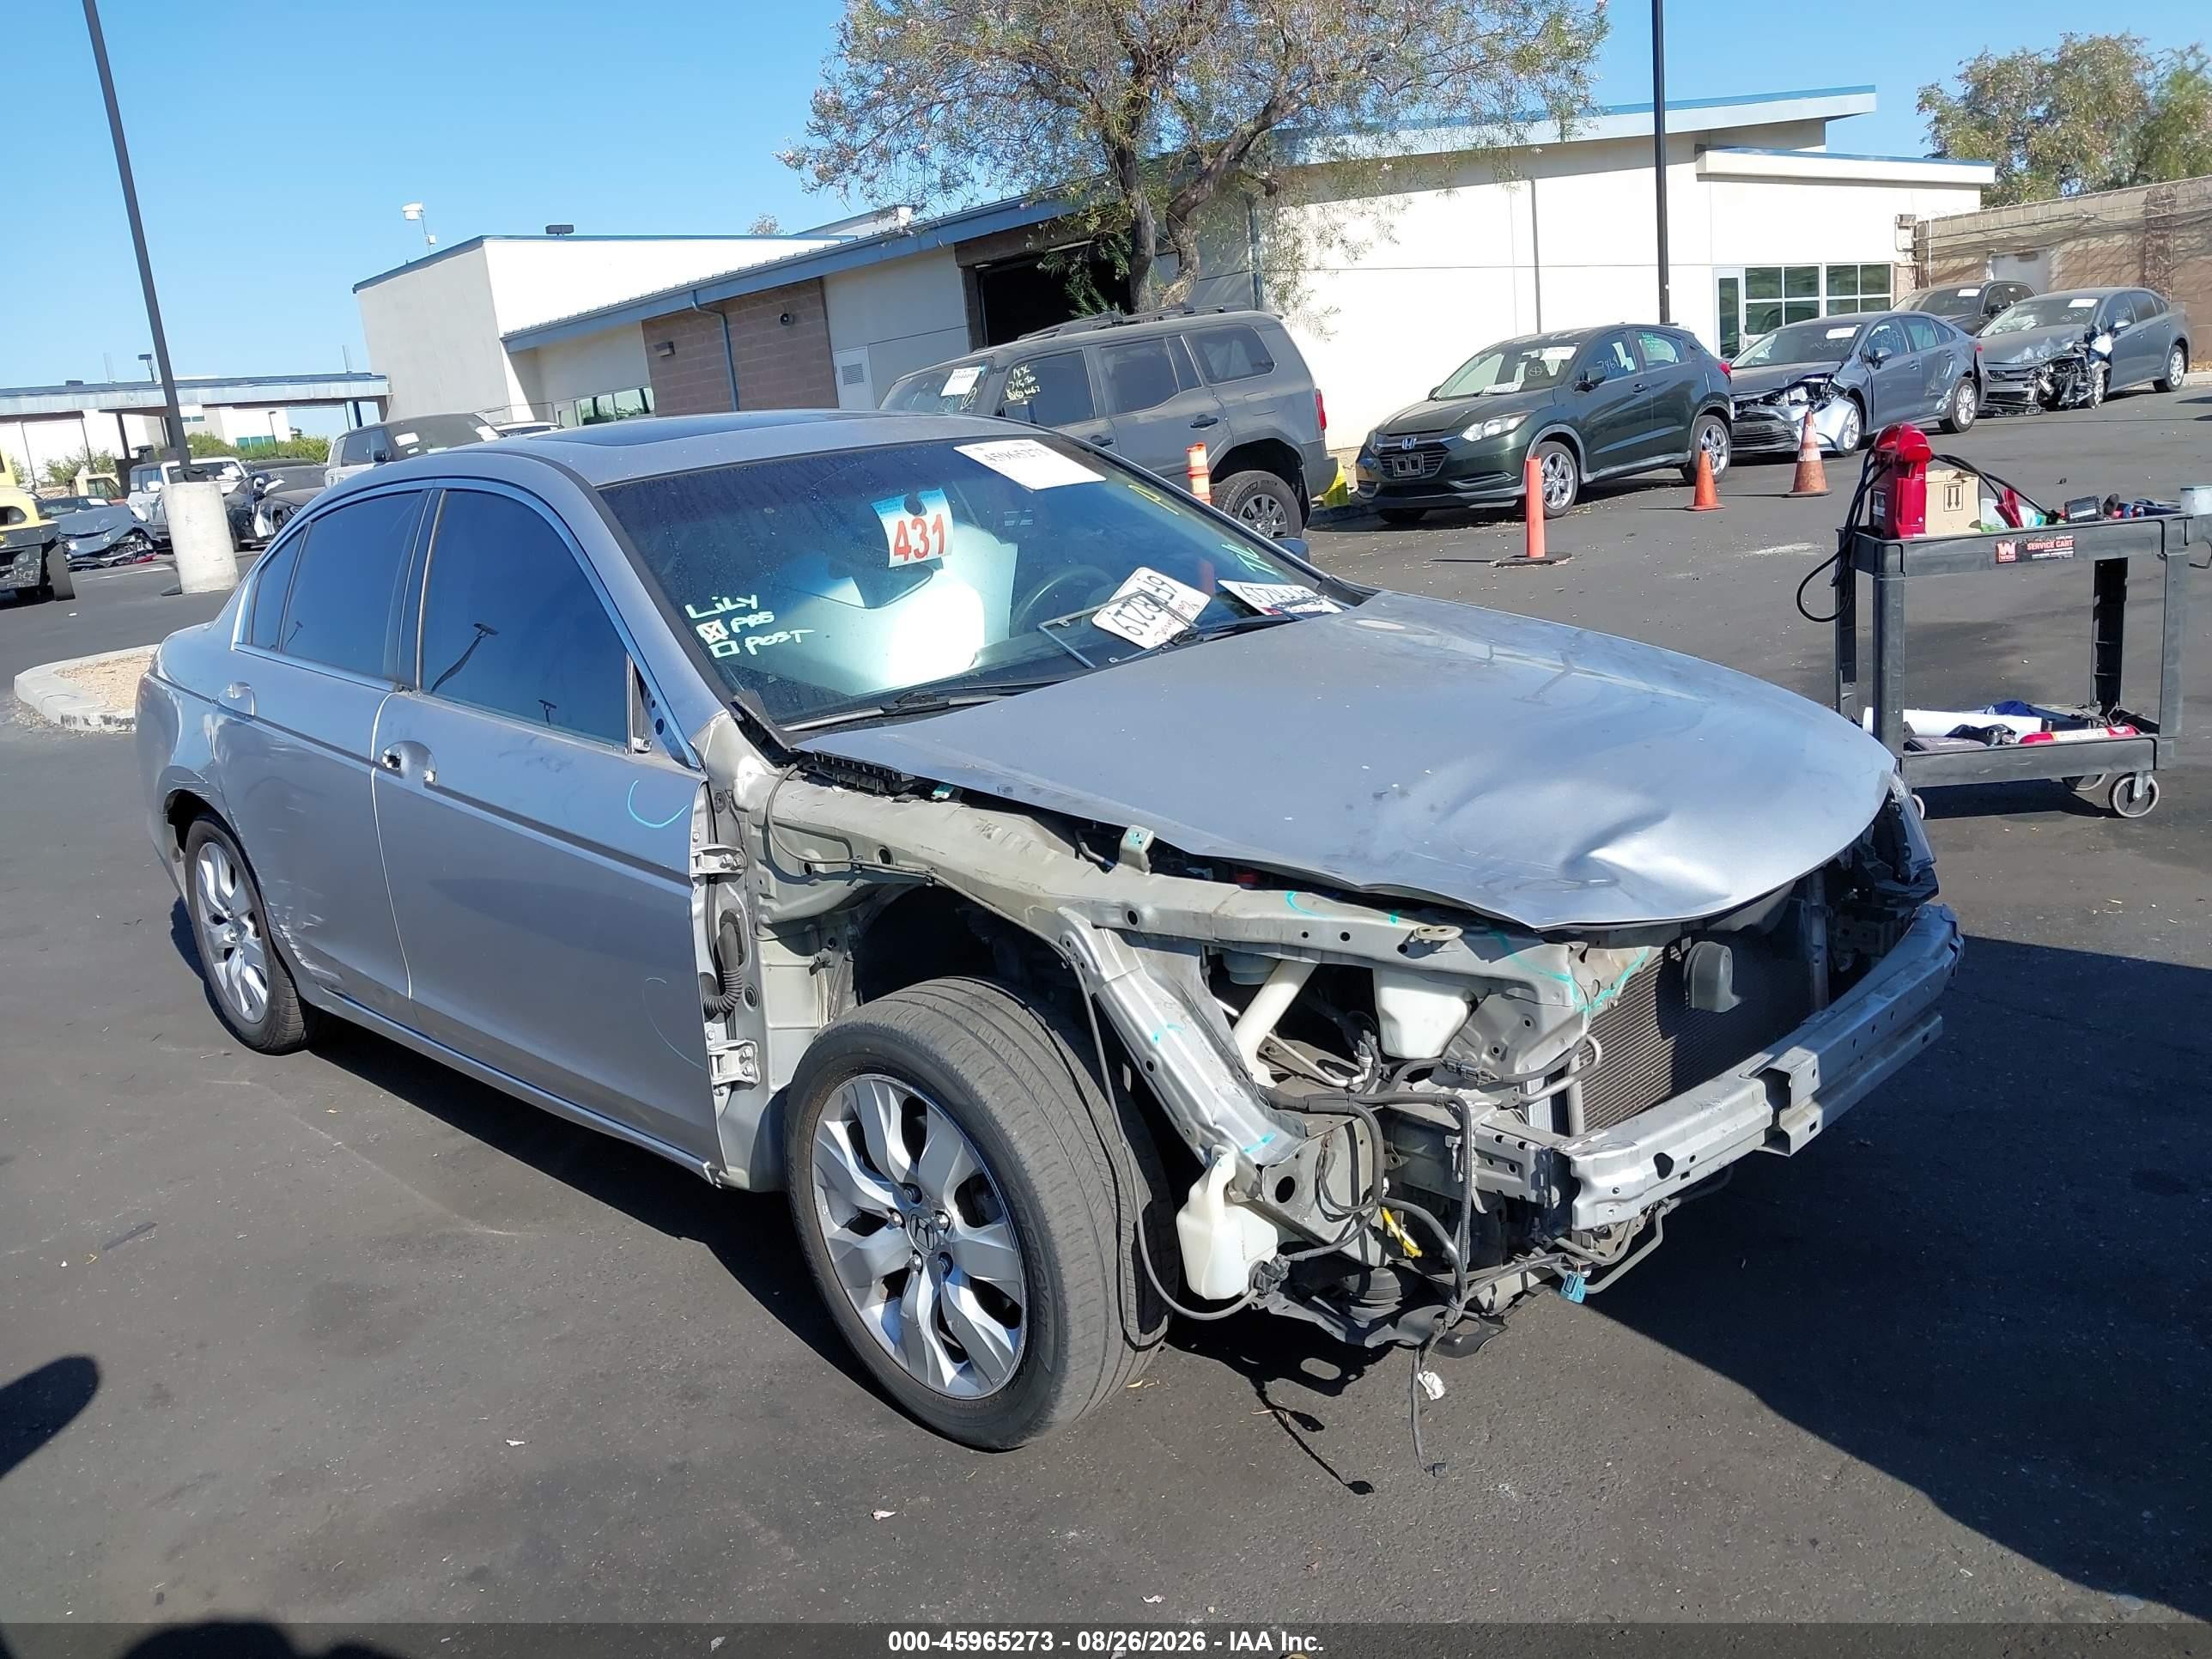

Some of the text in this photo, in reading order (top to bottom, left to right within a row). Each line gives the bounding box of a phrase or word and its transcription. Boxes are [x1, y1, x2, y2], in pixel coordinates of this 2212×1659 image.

[893, 514, 945, 561] 431
[2027, 541, 2054, 550] SERVICE
[744, 629, 816, 655] POST
